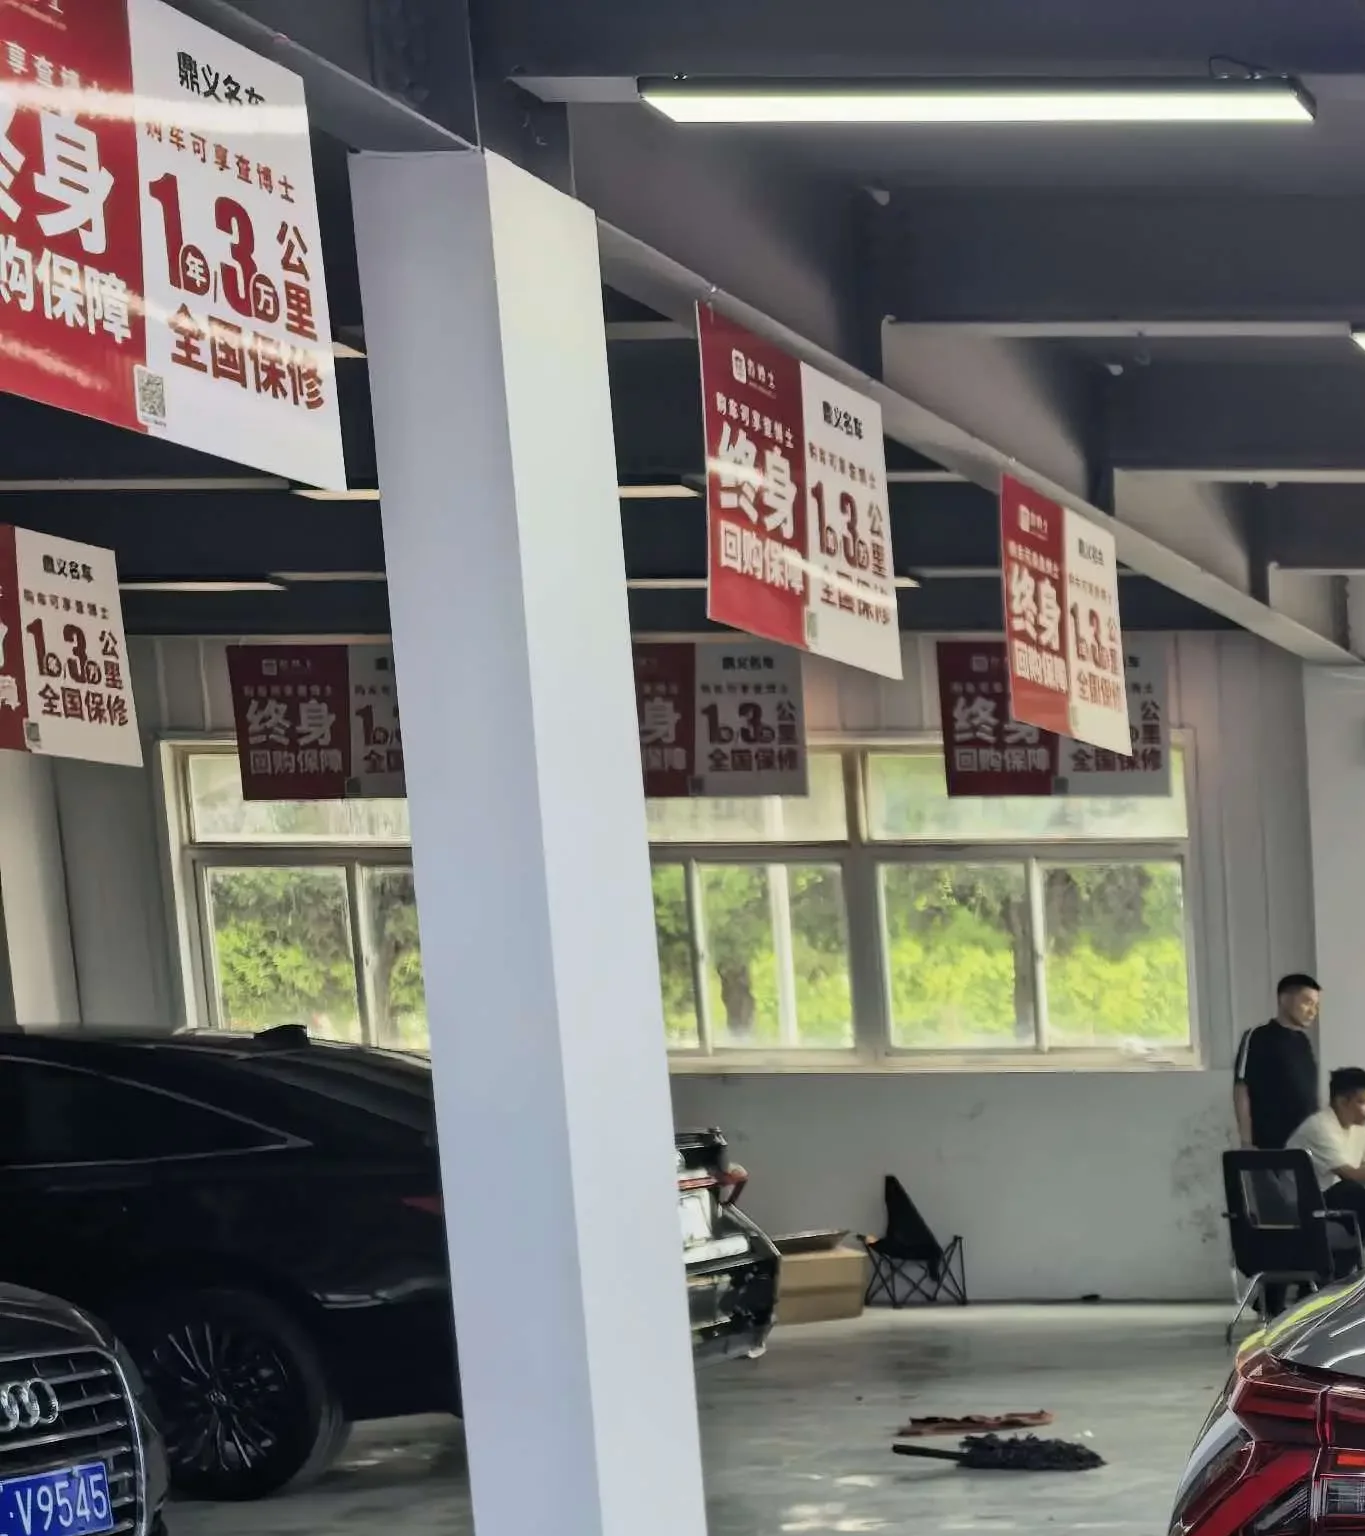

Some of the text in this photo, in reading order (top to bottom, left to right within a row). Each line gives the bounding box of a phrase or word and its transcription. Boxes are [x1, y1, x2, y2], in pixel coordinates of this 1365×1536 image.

[0, 104, 114, 254] 身
[167, 303, 324, 409] 全国保修
[718, 421, 797, 540] 终身
[1011, 563, 1061, 651] 终身
[39, 683, 128, 727] 全国保修
[245, 698, 336, 746] 终身
